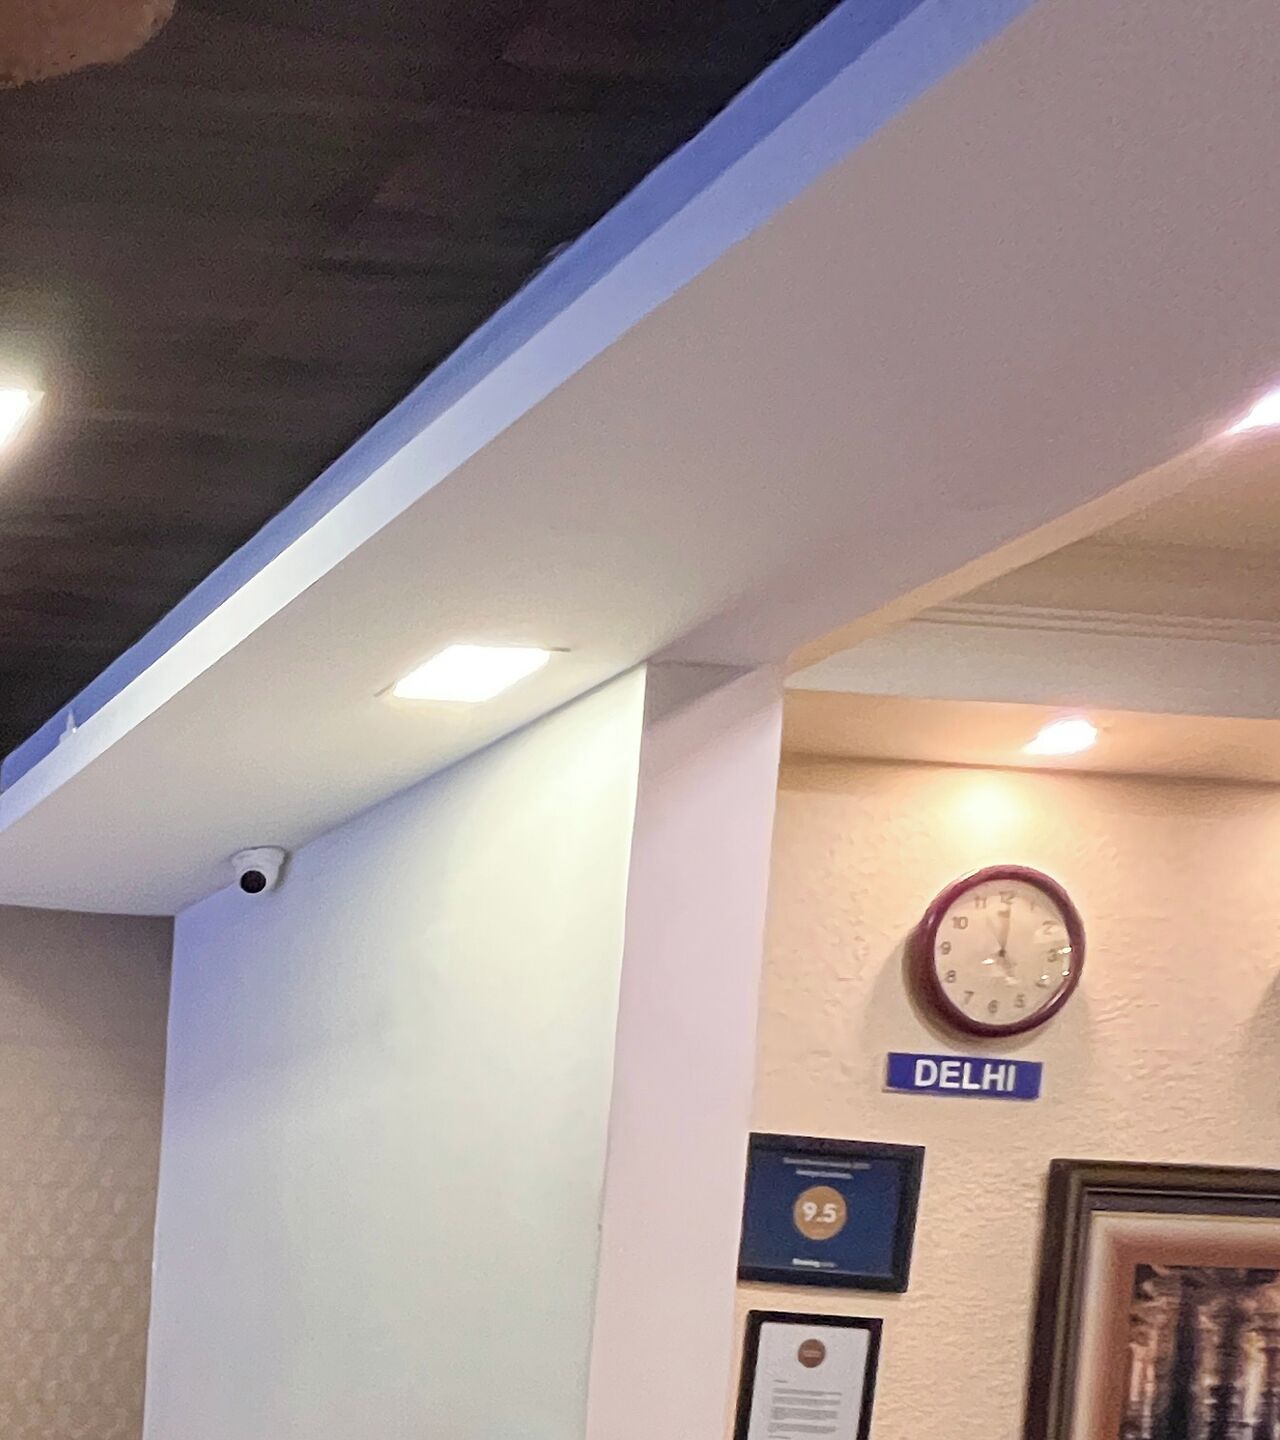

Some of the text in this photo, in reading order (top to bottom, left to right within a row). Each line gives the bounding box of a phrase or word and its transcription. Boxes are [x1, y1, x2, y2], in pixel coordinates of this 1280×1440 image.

[952, 916, 969, 930] 10
[941, 941, 952, 955] 9
[946, 969, 957, 983] 8
[964, 990, 975, 1004] 7
[1015, 993, 1026, 1008] 5
[987, 999, 998, 1013] 6
[914, 1059, 1016, 1092] DELHI
[802, 1202, 838, 1223] 9.5
